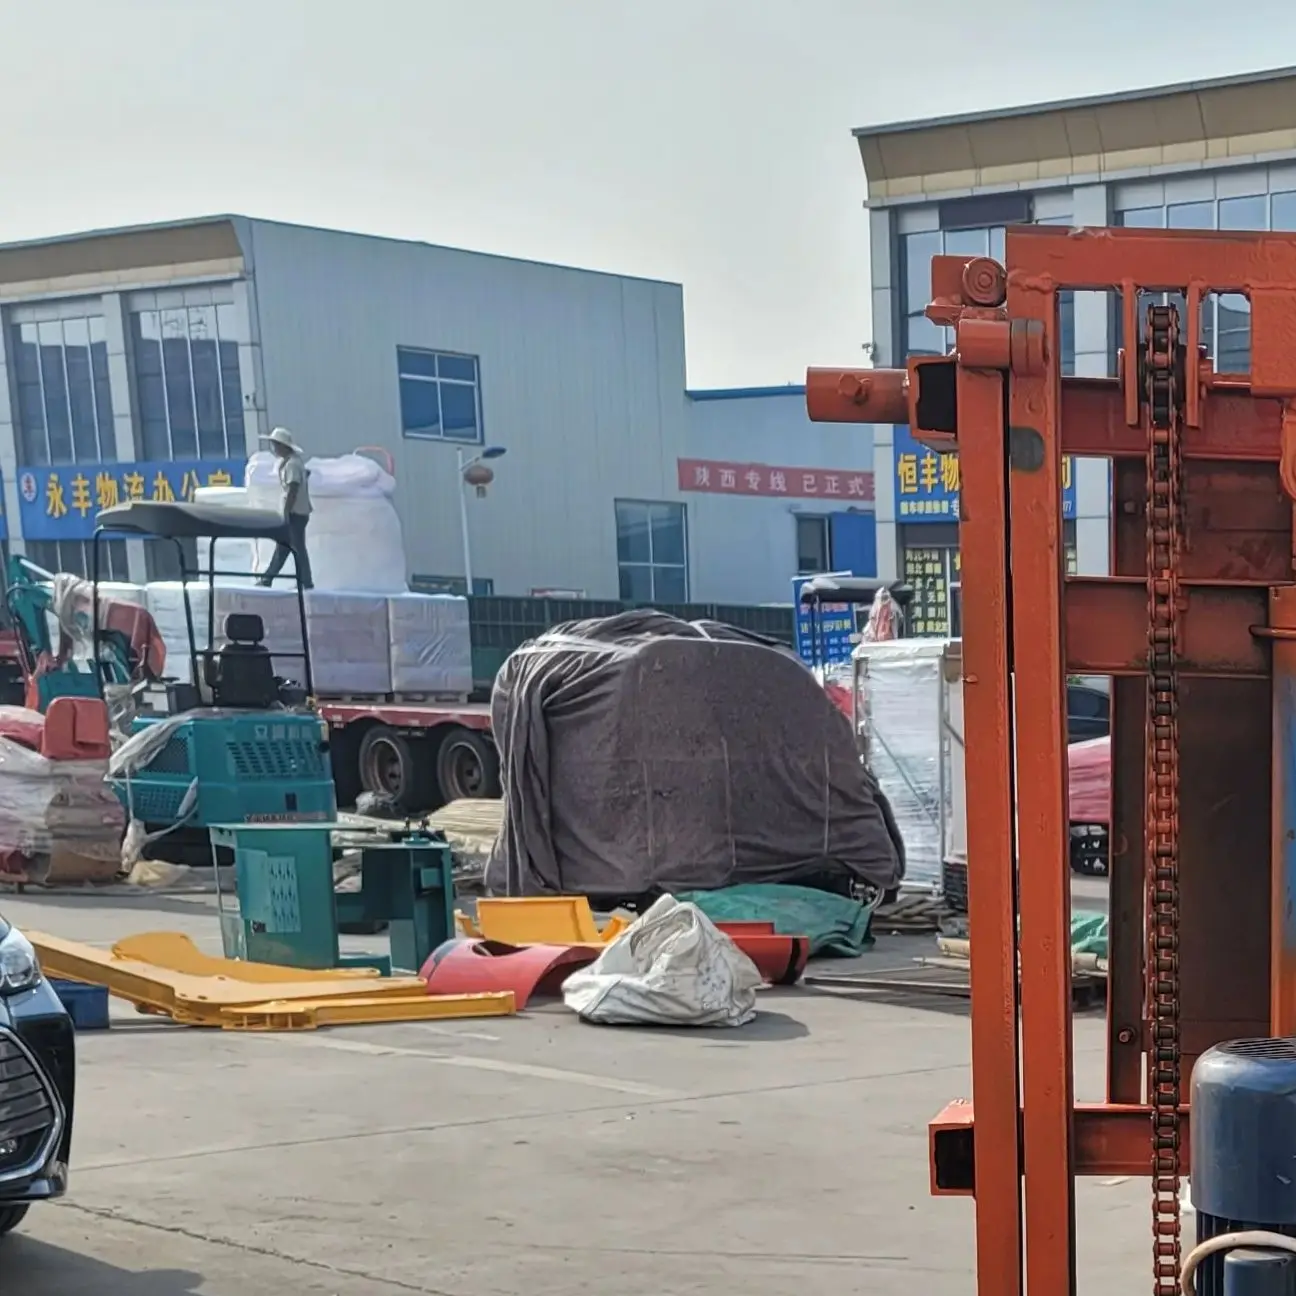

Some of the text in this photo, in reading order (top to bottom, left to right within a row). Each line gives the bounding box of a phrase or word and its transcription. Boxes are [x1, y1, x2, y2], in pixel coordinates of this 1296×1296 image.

[694, 466, 876, 496] 陕西专线 已正式
